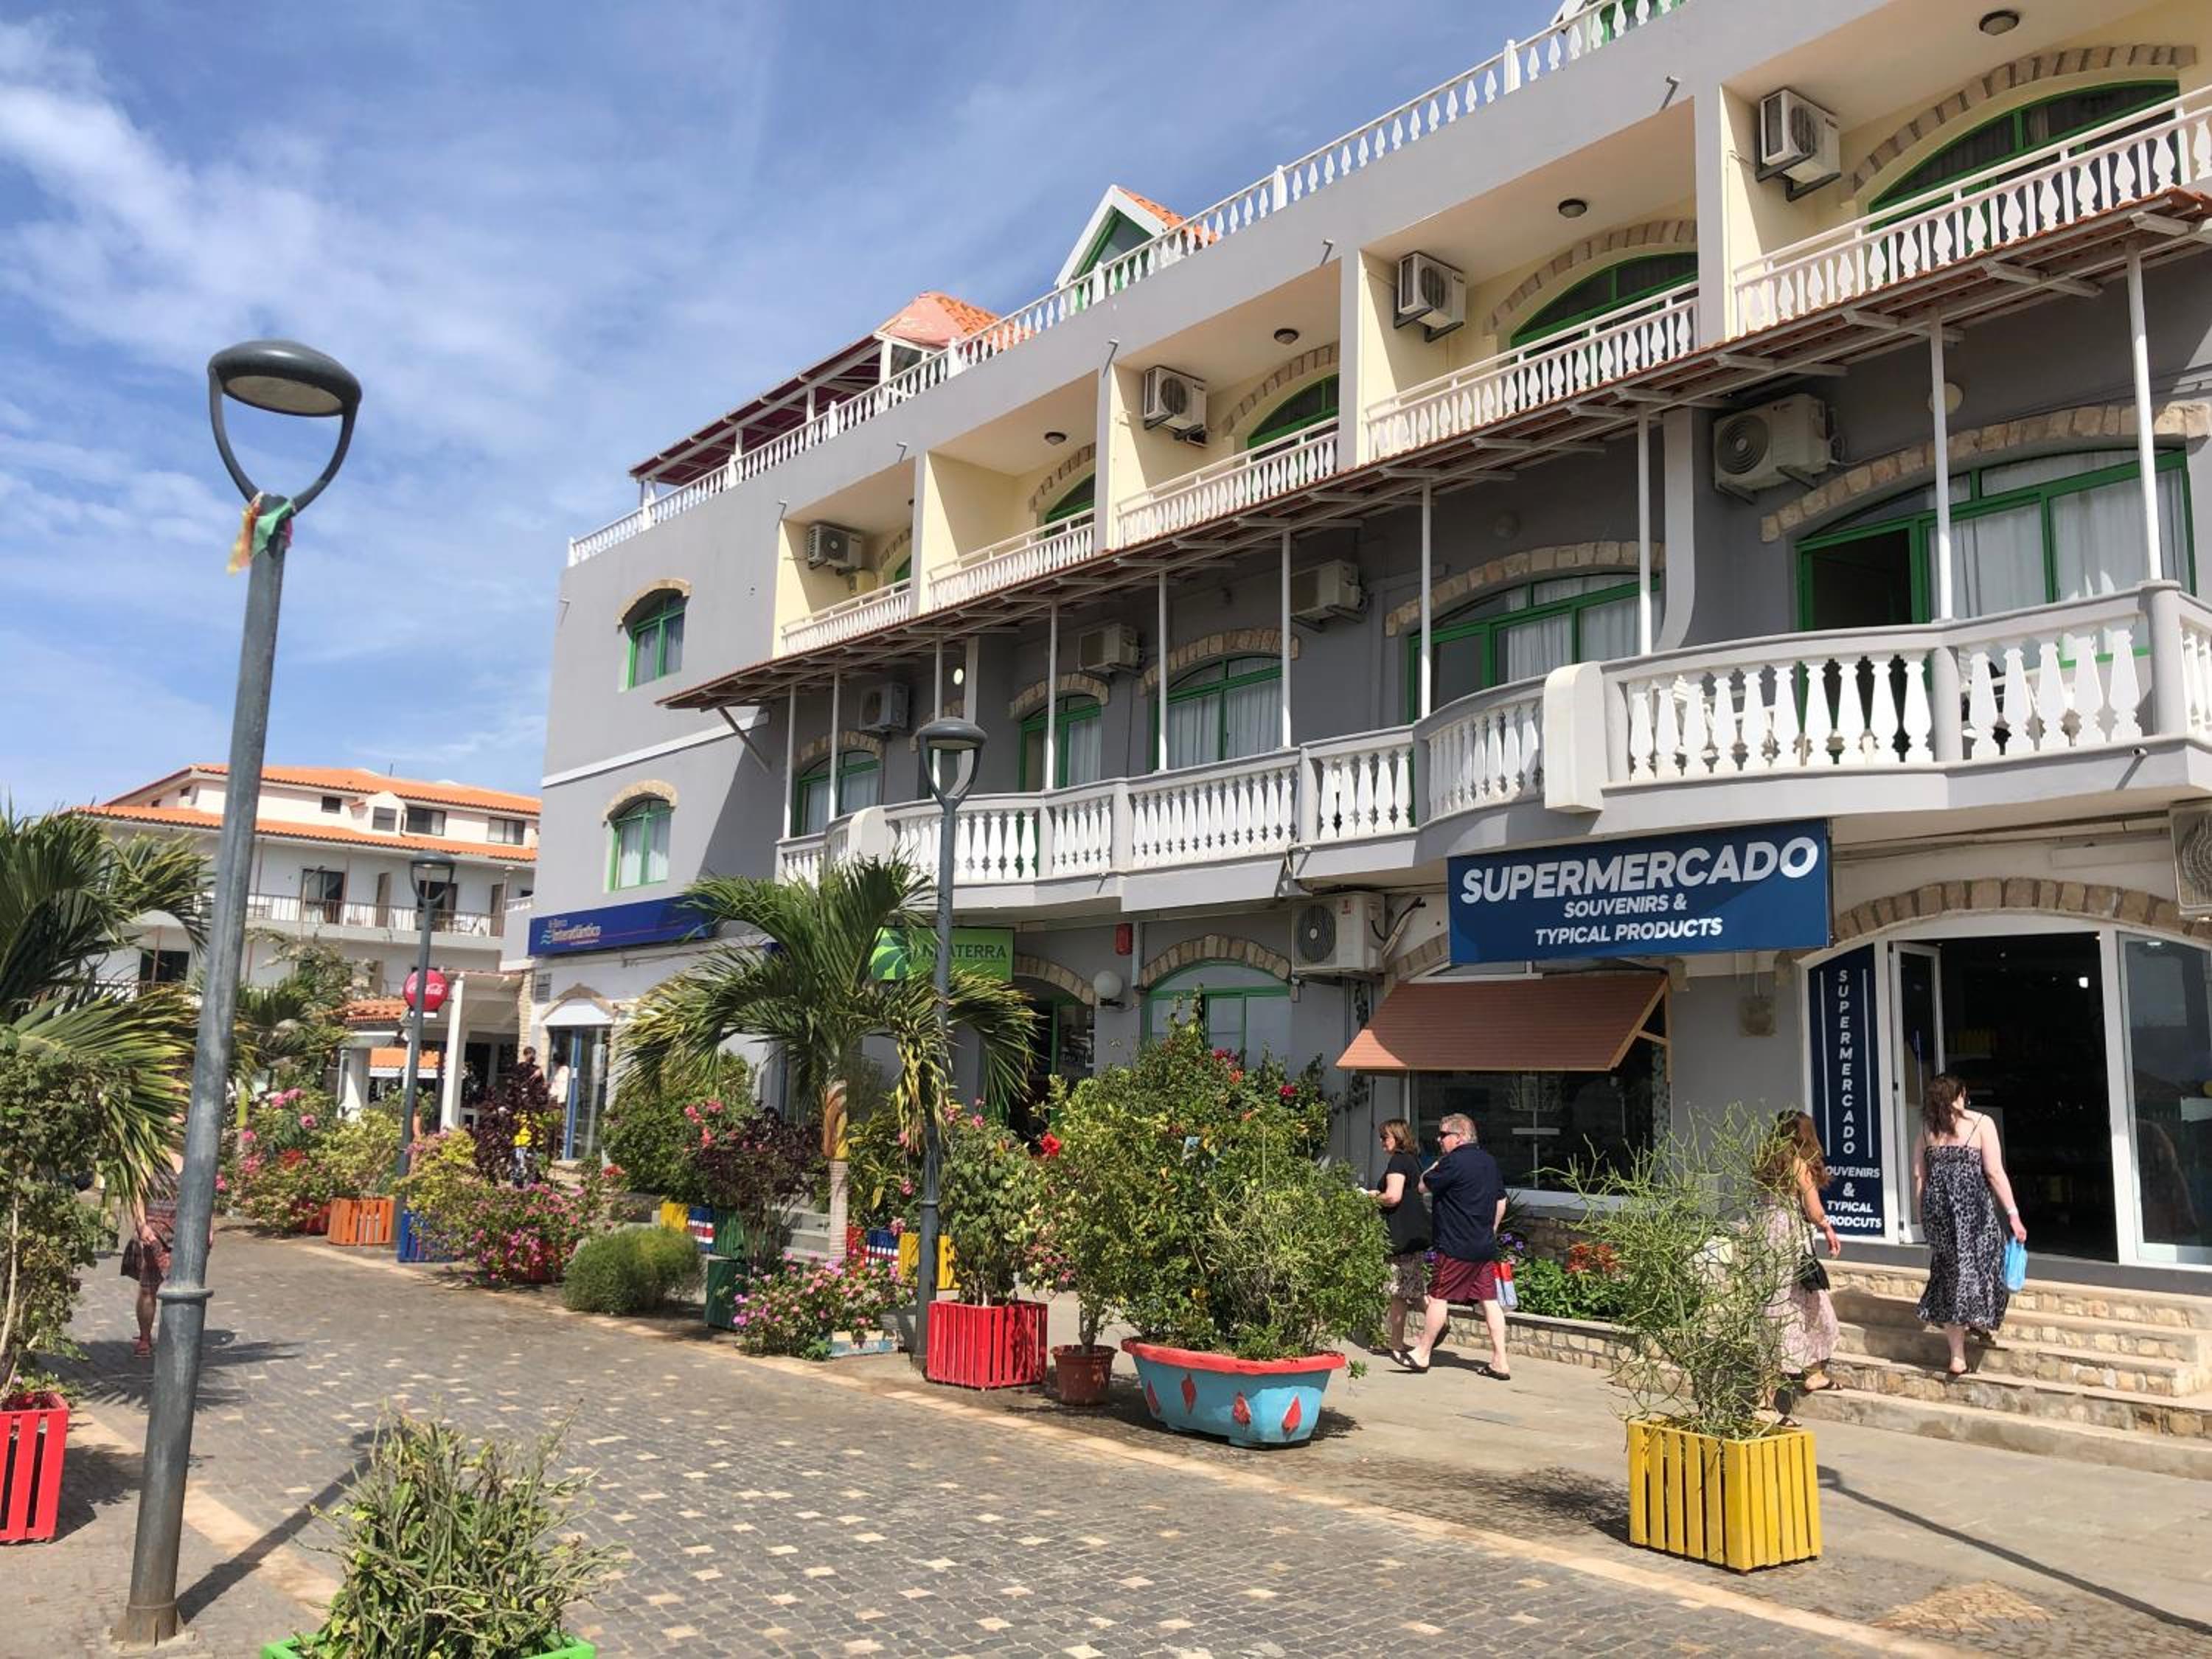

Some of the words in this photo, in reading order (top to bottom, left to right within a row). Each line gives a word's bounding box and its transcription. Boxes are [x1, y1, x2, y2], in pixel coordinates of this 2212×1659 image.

[1461, 836, 1819, 904] SUPERMERCADO
[1563, 894, 1669, 919] SOUVENIRS
[1674, 894, 1687, 911] &
[1535, 924, 1610, 946] TYPICAL
[1614, 917, 1723, 941] PRODUCTS
[1838, 970, 1855, 1155] SUPERMERCADO
[1825, 1166, 1880, 1178] OUVENIRS
[1843, 1182, 1855, 1197] &
[1827, 1200, 1874, 1213] TYPICAL
